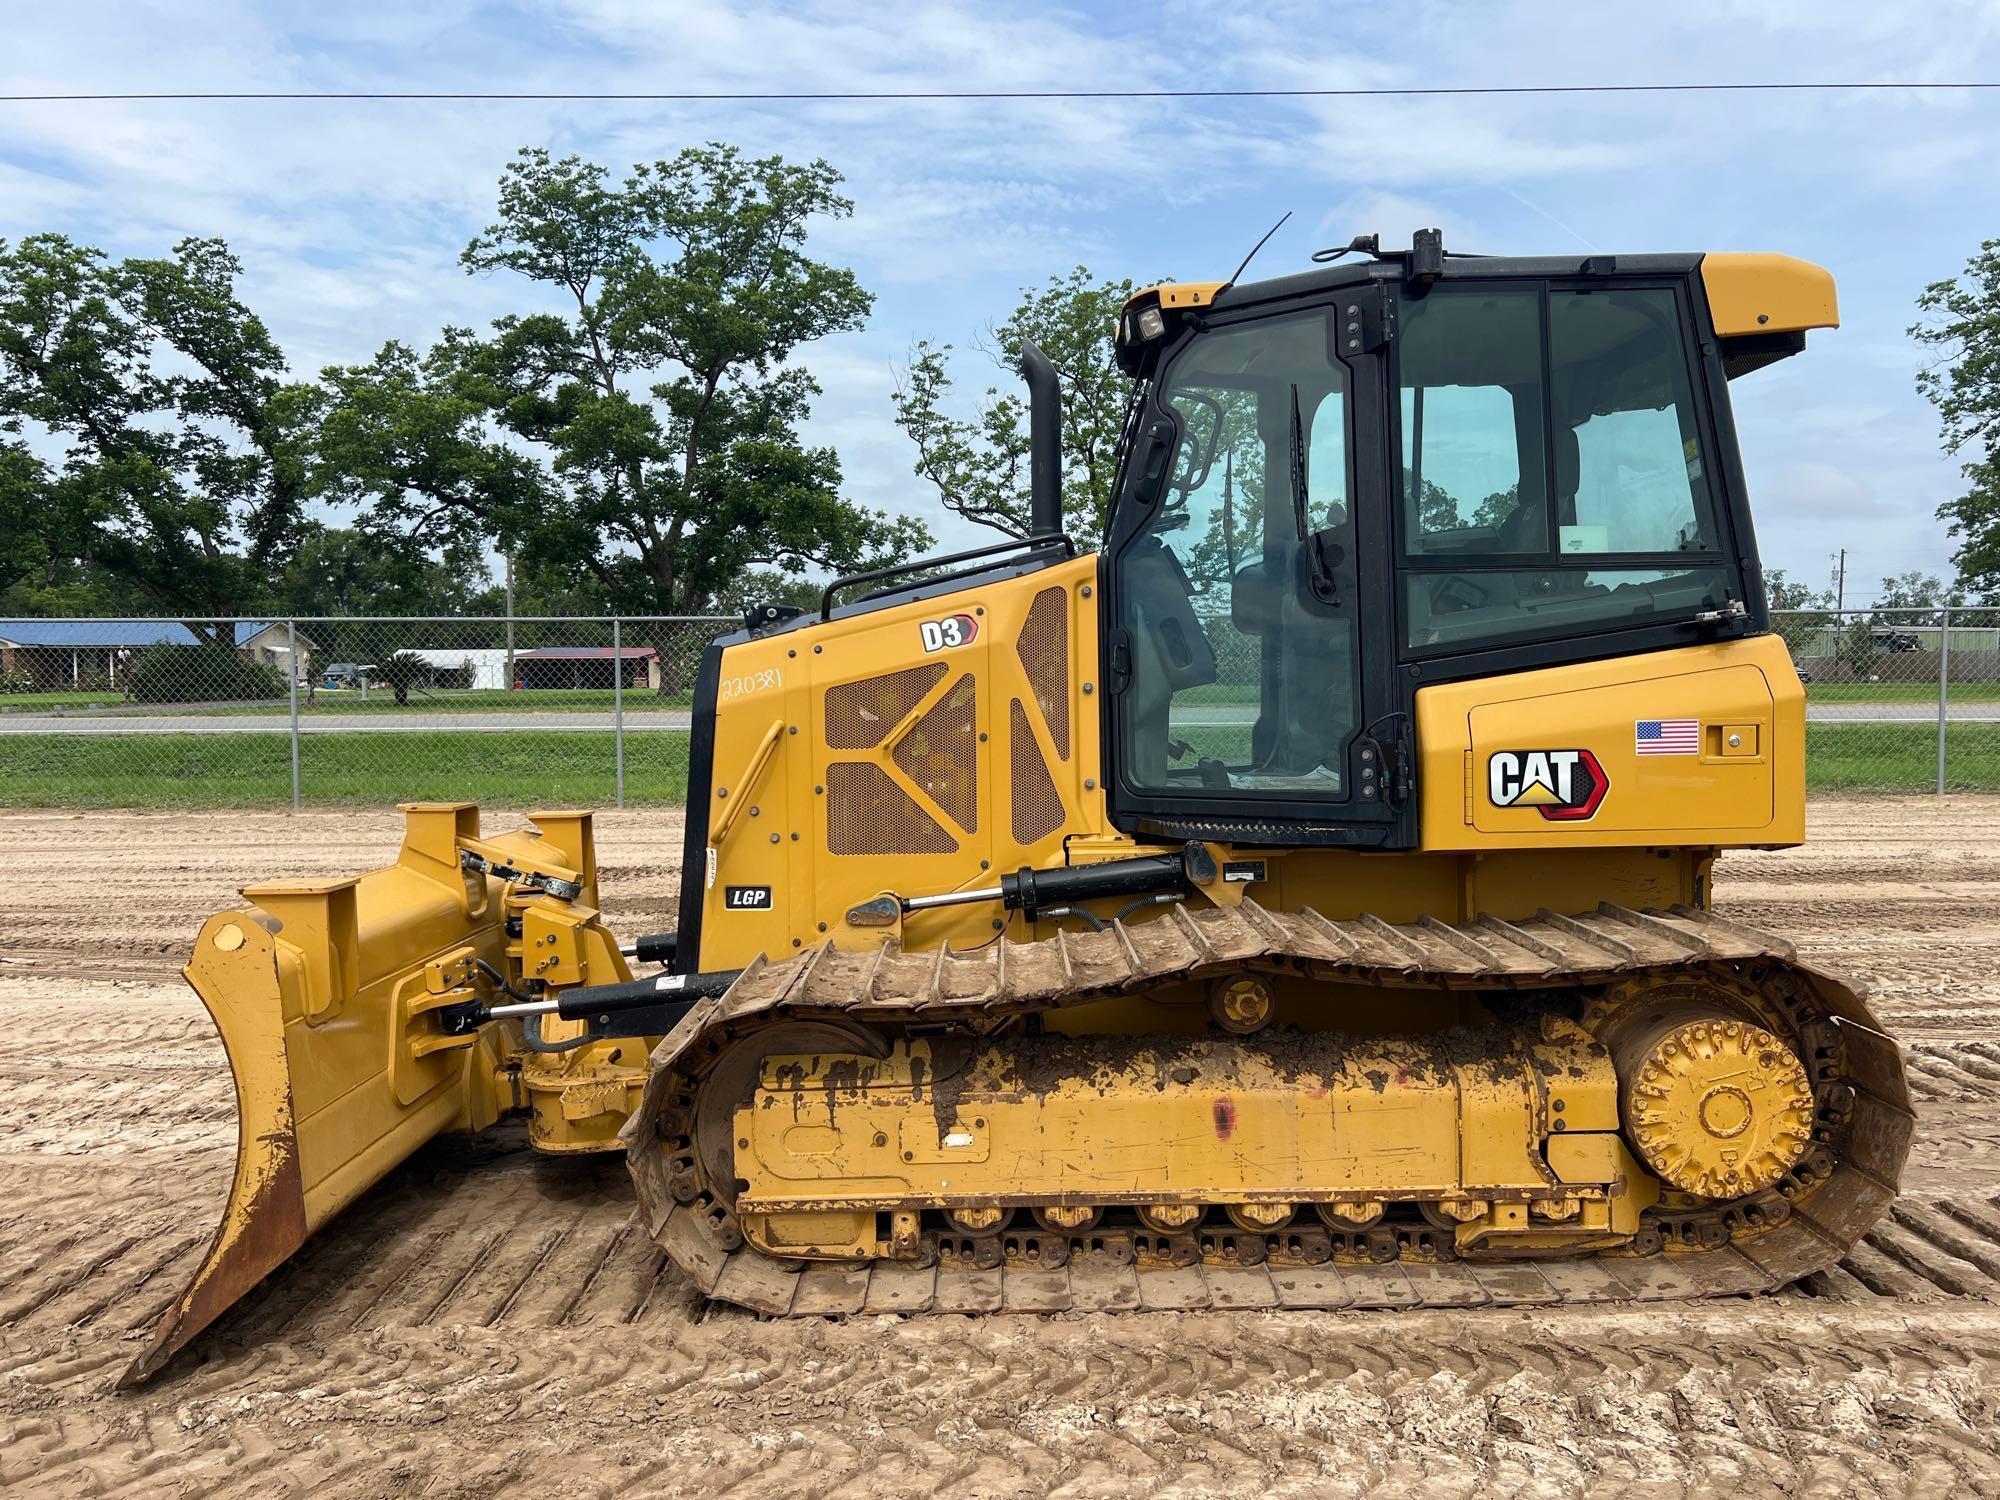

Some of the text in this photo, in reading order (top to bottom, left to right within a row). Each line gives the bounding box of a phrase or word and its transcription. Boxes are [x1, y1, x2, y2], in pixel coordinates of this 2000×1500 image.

[920, 617, 962, 652] D3
[722, 668, 782, 700] 220381
[1490, 751, 1579, 806] CAT
[732, 889, 766, 905] LGP
